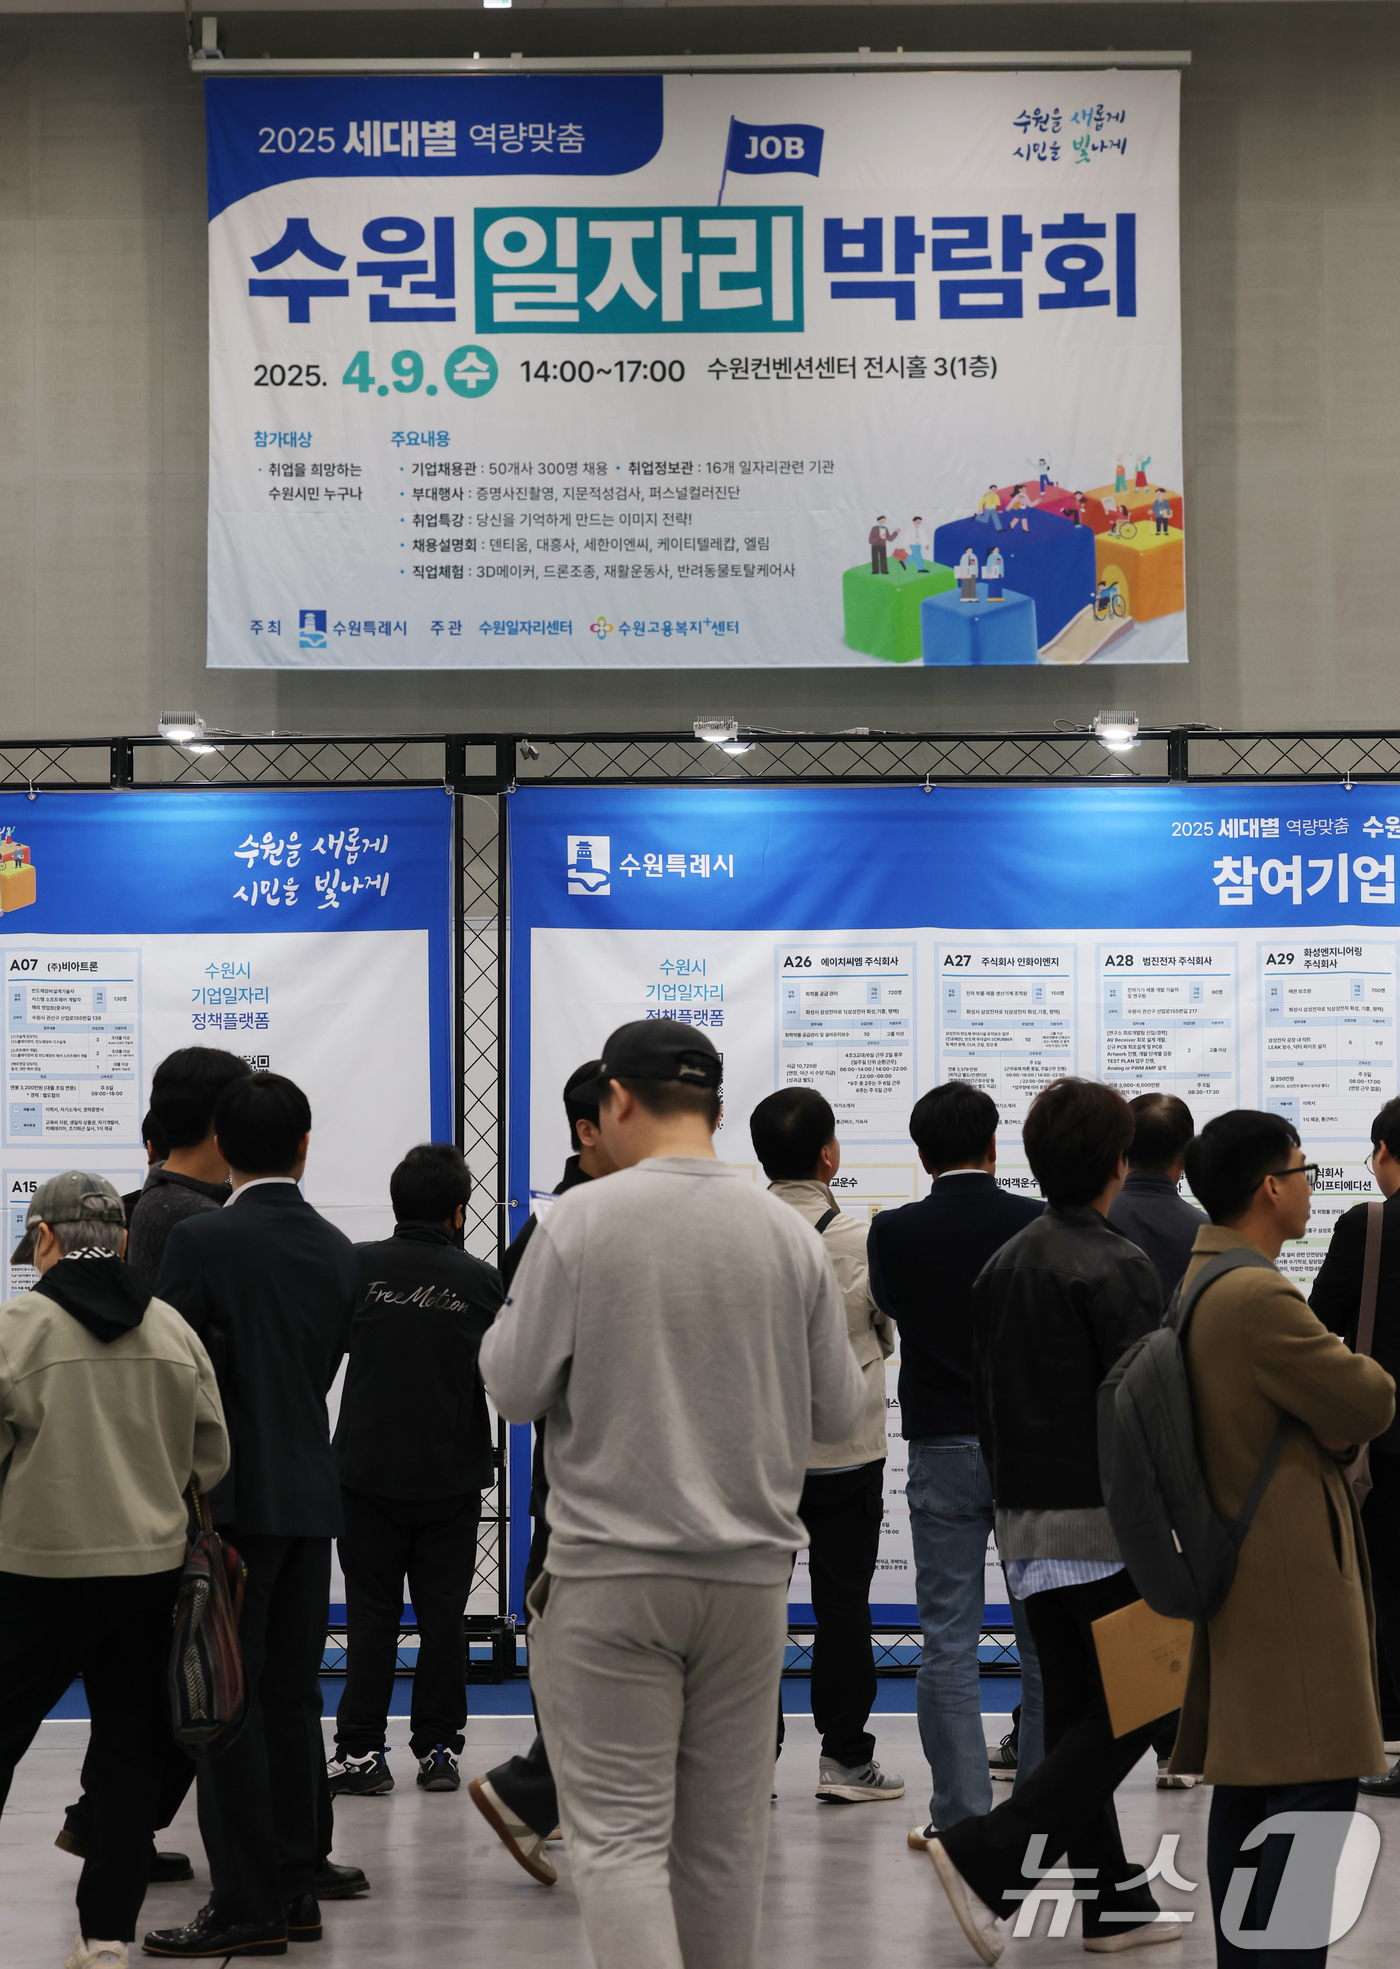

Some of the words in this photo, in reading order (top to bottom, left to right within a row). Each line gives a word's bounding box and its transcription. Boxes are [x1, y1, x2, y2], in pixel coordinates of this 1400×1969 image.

[1013, 106, 1062, 134] 수원을
[1070, 106, 1126, 134] 새롭게
[258, 127, 336, 153] 2025
[343, 120, 457, 157] 세대별
[469, 122, 585, 154] 역량맞춤
[745, 135, 805, 160] JOB
[1013, 139, 1061, 162] 시민을
[1072, 136, 1127, 164] 빛나게
[248, 215, 456, 323] 수원
[483, 214, 794, 323] 일자리
[823, 213, 1137, 321] 박람회
[253, 364, 328, 387] 2025.
[342, 349, 438, 397] 4.9.
[520, 359, 686, 383] 14:00~17:00
[707, 356, 857, 381] 수원컨벤션센터
[863, 355, 928, 380] 전시홀
[933, 354, 998, 380] 3(1층)
[253, 431, 312, 448] 참가대상
[390, 430, 451, 447] 주요내용
[268, 462, 306, 478] 취업을
[311, 462, 362, 478] 희망하는
[411, 461, 477, 476] 기업채용관
[489, 461, 534, 476] 50개사
[537, 461, 578, 476] 300명
[582, 461, 608, 476] 채용
[628, 460, 693, 475] 취업정보관
[706, 460, 735, 475] 16개
[739, 460, 804, 475] 일자리관련
[809, 460, 835, 475] 기관
[268, 486, 320, 501] 수원시민
[323, 486, 363, 501] 누구나
[411, 486, 464, 502] 부대행사
[476, 486, 559, 502] 증명사진촬영,
[562, 486, 645, 502] 지문적성검사,
[649, 486, 741, 502] 퍼스널컬러진단
[411, 512, 464, 527] 취업특강
[476, 512, 515, 527] 당신을
[519, 512, 572, 527] 기억하게
[576, 512, 615, 527] 만드는
[619, 512, 658, 527] 이미지
[662, 512, 693, 527] 전략!
[412, 537, 477, 553] 채용설명회
[489, 537, 532, 553] 덴티움,
[583, 537, 653, 553] 세한이엔씨,
[657, 537, 740, 553] 케이티텔레캅,
[744, 537, 770, 553] 엘림
[412, 564, 464, 580] 직업체험
[476, 564, 539, 580] 3D메이커,
[543, 564, 599, 580] 드론조종,
[603, 564, 673, 580] 재활운동사,
[677, 564, 796, 580] 반려동물토탈케어사
[333, 620, 408, 637] 수원특례시
[479, 620, 573, 636] 수원일자리센터
[1171, 820, 1214, 838] 2025
[1217, 817, 1280, 838] 세대별
[1286, 817, 1350, 836] 역량맞춤
[233, 831, 302, 869] 수원을
[310, 827, 390, 866] 새롭게
[619, 853, 735, 879] 수원특례시
[1212, 852, 1396, 907] 참여기업
[232, 877, 300, 906] 시민을
[314, 869, 390, 909] 빛나게
[943, 954, 972, 967] A27
[981, 957, 1016, 967] 주식회사
[1017, 957, 1059, 967] 인화이엔지
[1105, 954, 1134, 967] A28
[1142, 956, 1177, 966] 범진전자
[1178, 956, 1213, 966] 주식회사
[1266, 953, 1295, 965] A29
[1303, 947, 1363, 957] 화성엔지니어링
[10, 959, 38, 971] A07
[47, 961, 98, 973] (주)비아트론
[659, 958, 706, 977] 수원시
[783, 956, 812, 968] A26
[820, 957, 863, 967] 에이치씨엠
[864, 956, 899, 966] 주식회사
[1303, 959, 1338, 969] 주식회사
[204, 962, 251, 981] 수원시
[191, 986, 270, 1006] 기업일자리
[645, 983, 725, 1003] 기업일자리
[191, 1012, 270, 1032] 정책플랫폼
[12, 1181, 38, 1193] A15
[828, 1177, 858, 1188] 교운수
